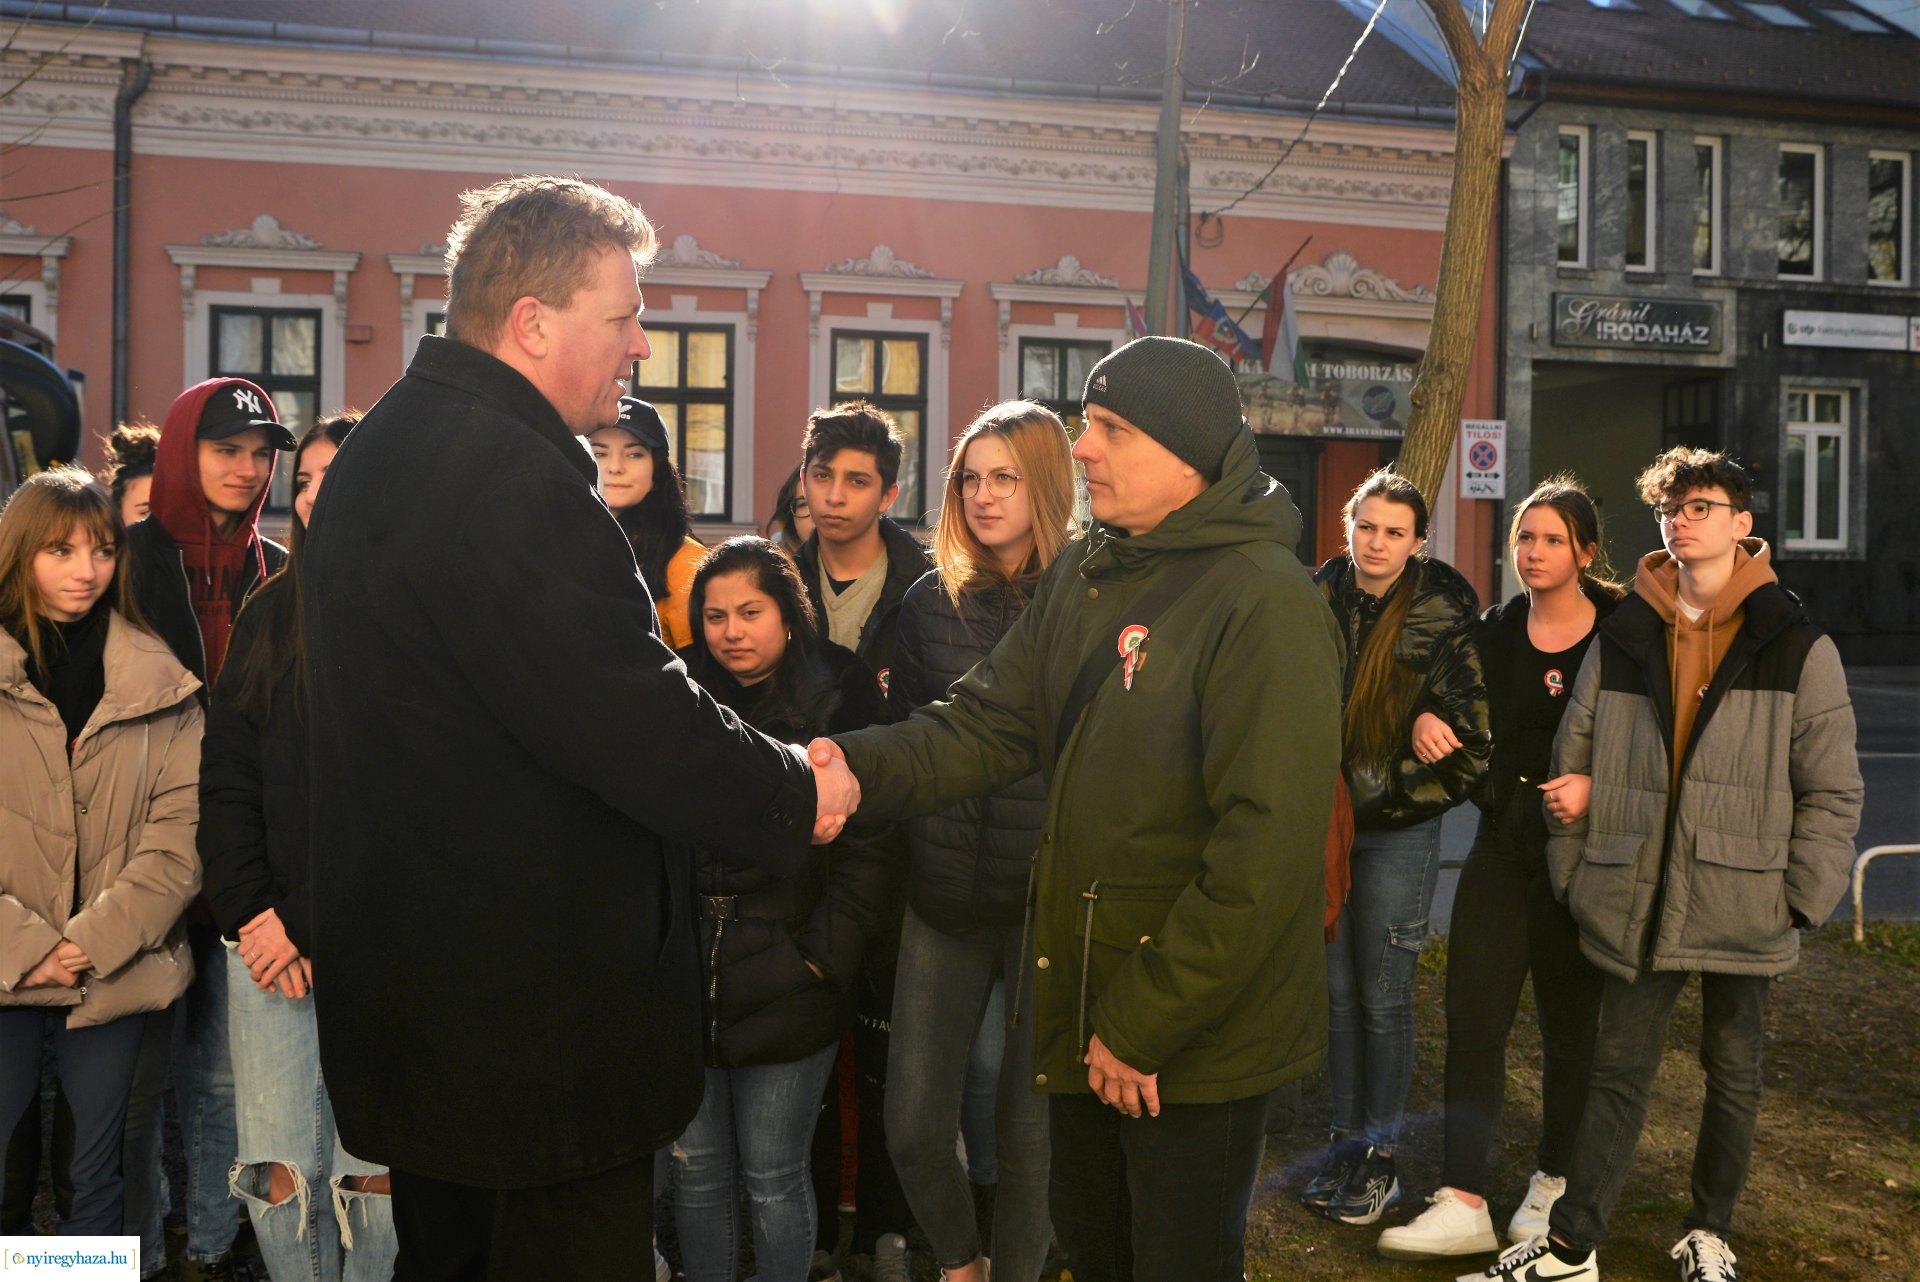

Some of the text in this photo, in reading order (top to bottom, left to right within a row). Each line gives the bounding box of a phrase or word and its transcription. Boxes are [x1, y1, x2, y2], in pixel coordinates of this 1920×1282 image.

[1596, 321, 1710, 345] IRODAHÁZ
[1321, 362, 1413, 383] TOBORZÁS
[232, 388, 262, 414] NY
[1466, 431, 1502, 439] TILOS!
